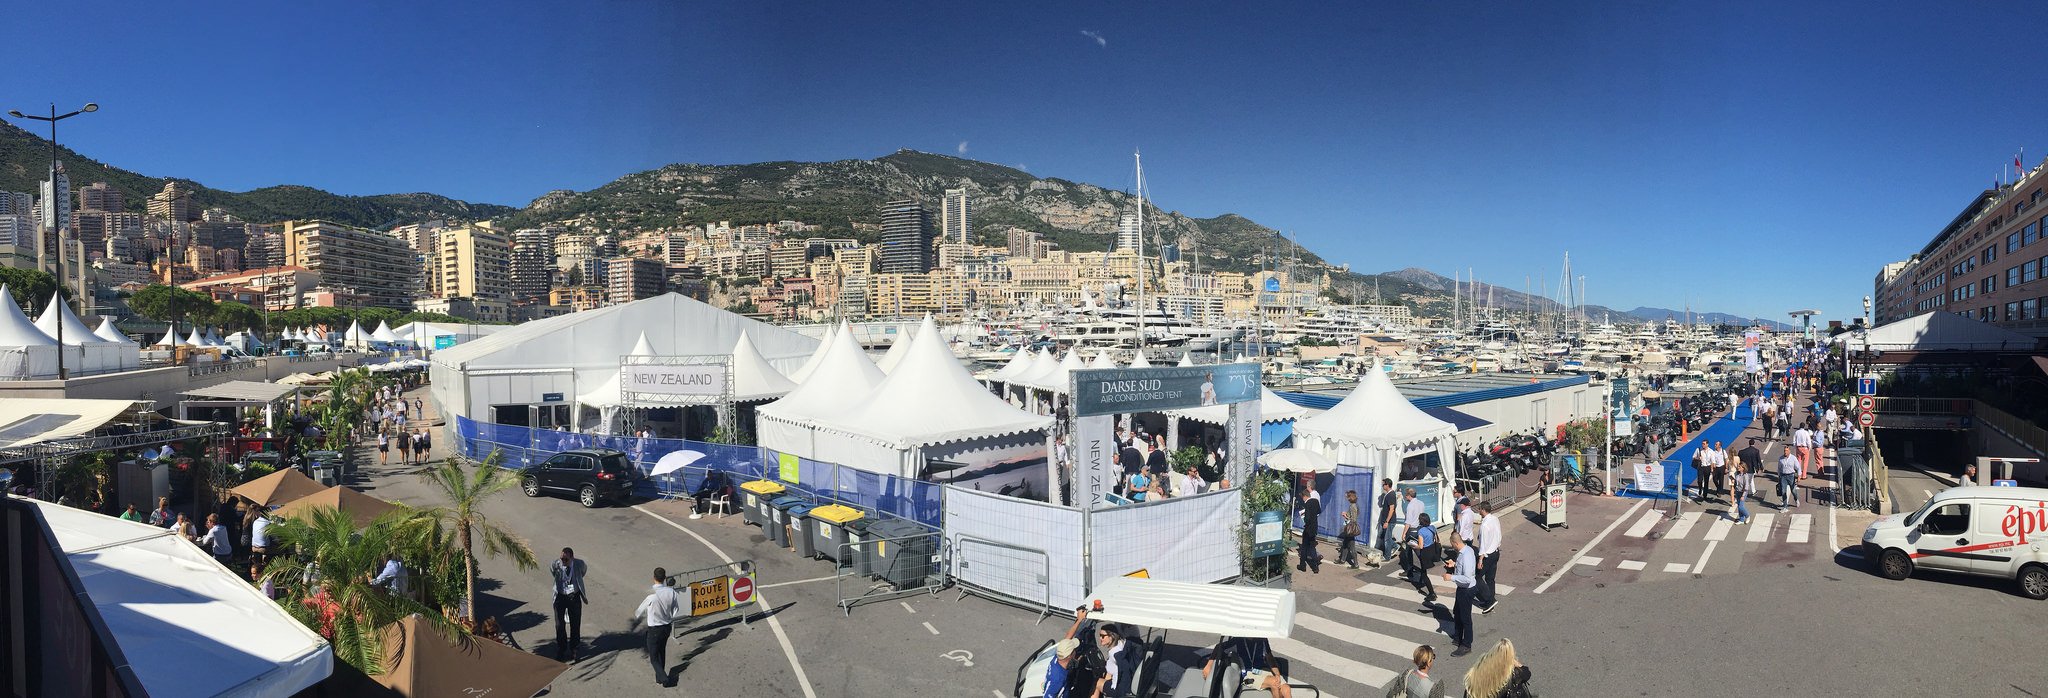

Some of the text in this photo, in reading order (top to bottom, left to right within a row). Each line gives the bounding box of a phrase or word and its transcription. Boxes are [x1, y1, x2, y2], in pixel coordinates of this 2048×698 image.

[634, 373, 712, 385] NEW ZEALAND
[1101, 379, 1161, 393] DARSE SUD
[1100, 391, 1182, 403] AIR CONDITIONED TENT
[1090, 440, 1100, 471] NEW
[694, 583, 722, 596] ROUTE
[692, 595, 726, 610] BARRÉE
